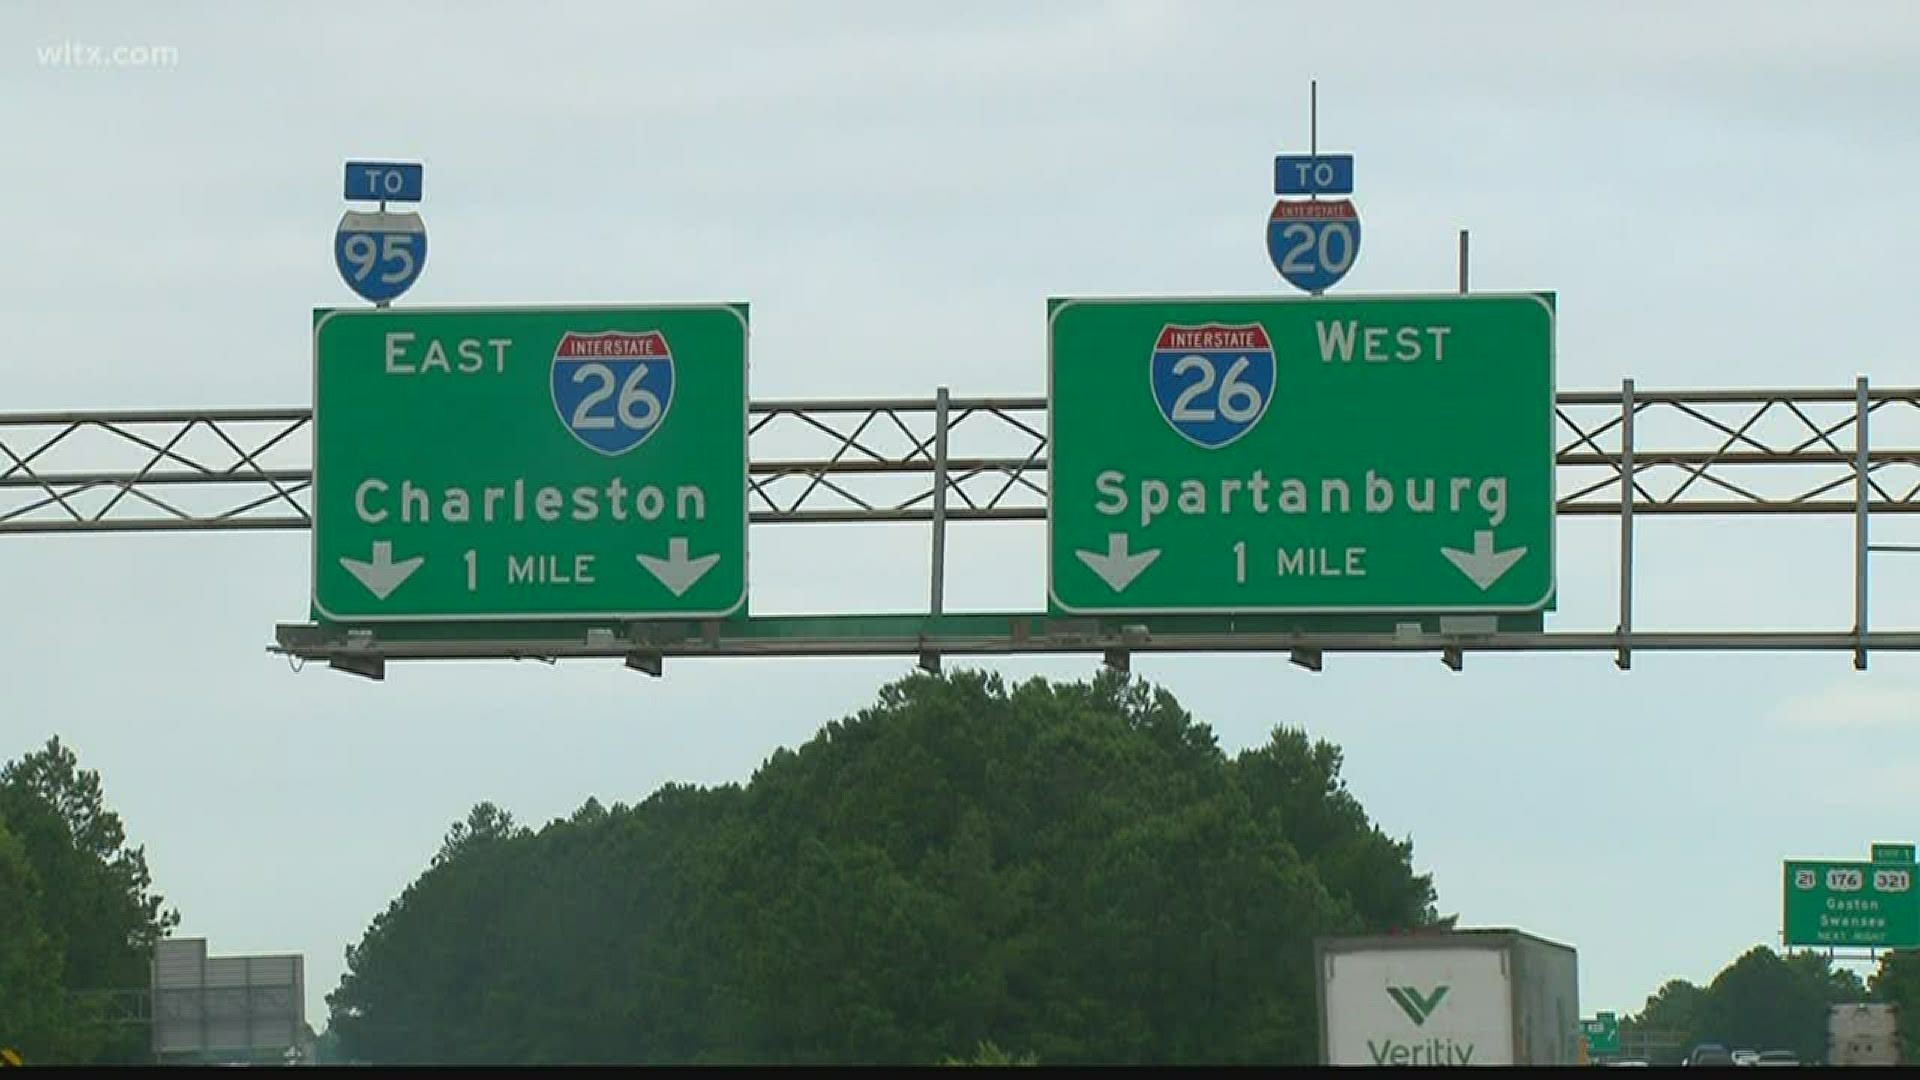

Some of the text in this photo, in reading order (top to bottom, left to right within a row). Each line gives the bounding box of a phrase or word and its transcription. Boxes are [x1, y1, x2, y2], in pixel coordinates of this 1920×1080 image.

[365, 169, 404, 193] TO
[1296, 163, 1333, 187] TO
[344, 234, 414, 284] 95
[1281, 223, 1353, 273] 20
[385, 332, 513, 373] EAST
[570, 338, 654, 356] INTERSTATE
[1170, 331, 1256, 348] INTERSTATE
[1315, 320, 1451, 362] WEST
[571, 363, 662, 430] 26
[1171, 356, 1263, 423] 26
[354, 477, 707, 523] Charleston
[1095, 469, 1508, 527] Spartanburg
[463, 550, 596, 591] 1 MILE
[1232, 542, 1367, 583] 1 MILE
[1798, 873, 1905, 887] 21 176 321
[1366, 1037, 1475, 1067] Veritiv
